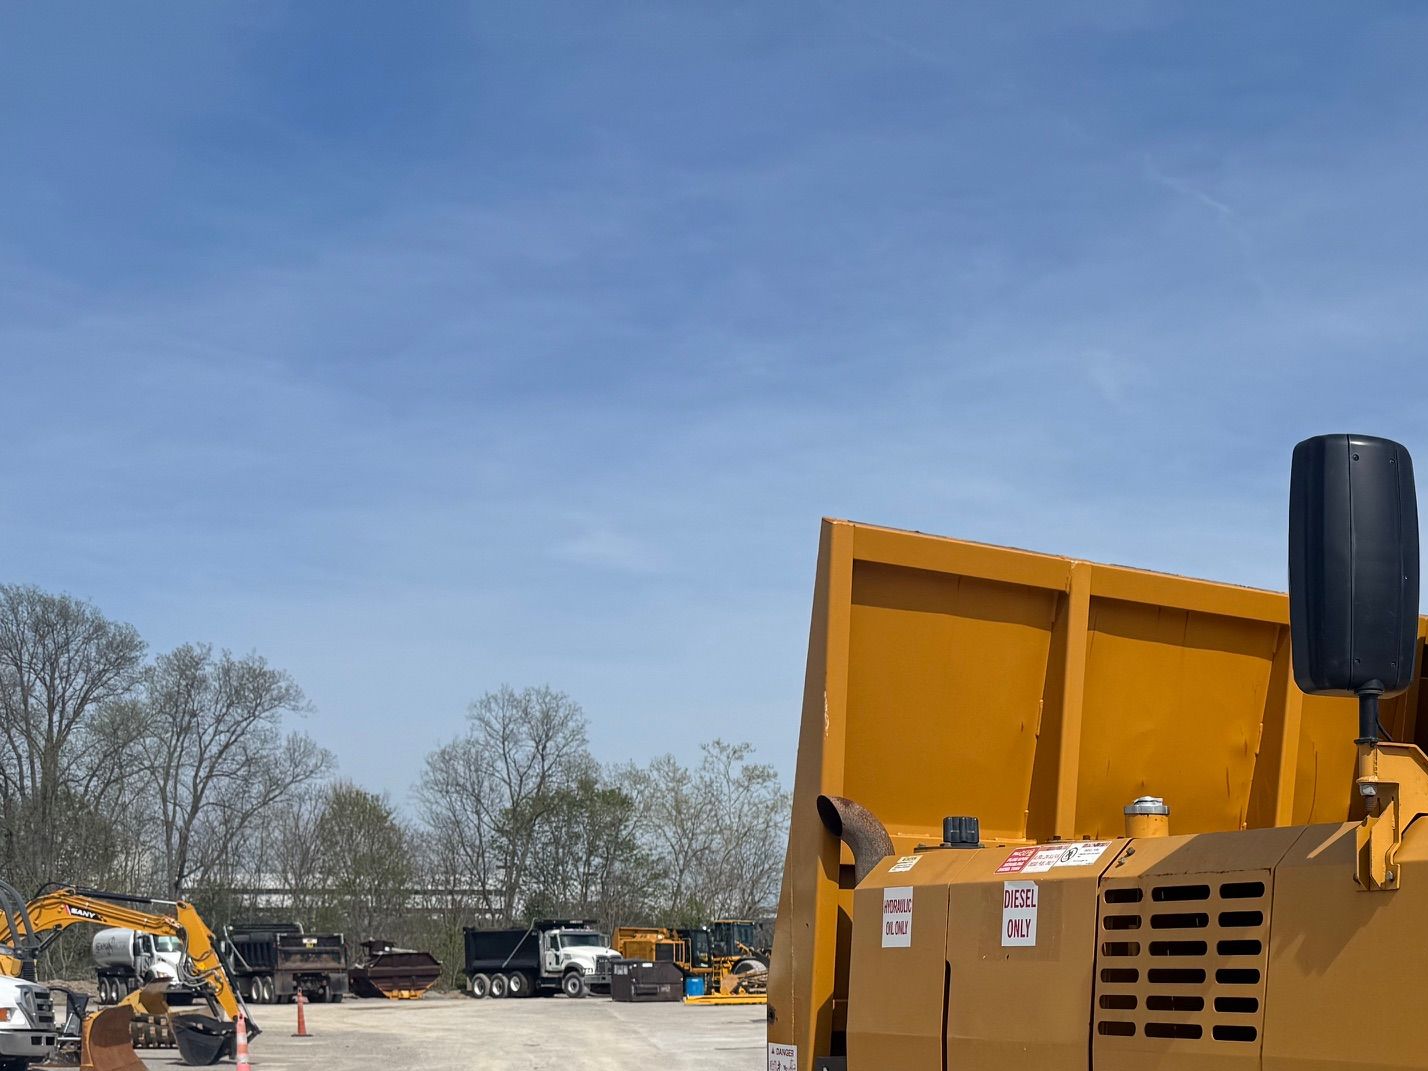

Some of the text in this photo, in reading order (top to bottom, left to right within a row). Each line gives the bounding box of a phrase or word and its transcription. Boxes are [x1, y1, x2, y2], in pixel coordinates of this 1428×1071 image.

[883, 898, 912, 914] HYDRAULIC
[1004, 888, 1037, 909] DIESEL
[70, 907, 96, 919] SANY
[885, 920, 909, 935] OIL ONLY
[1006, 918, 1032, 938] ONLY
[776, 1047, 795, 1057] DANGER
